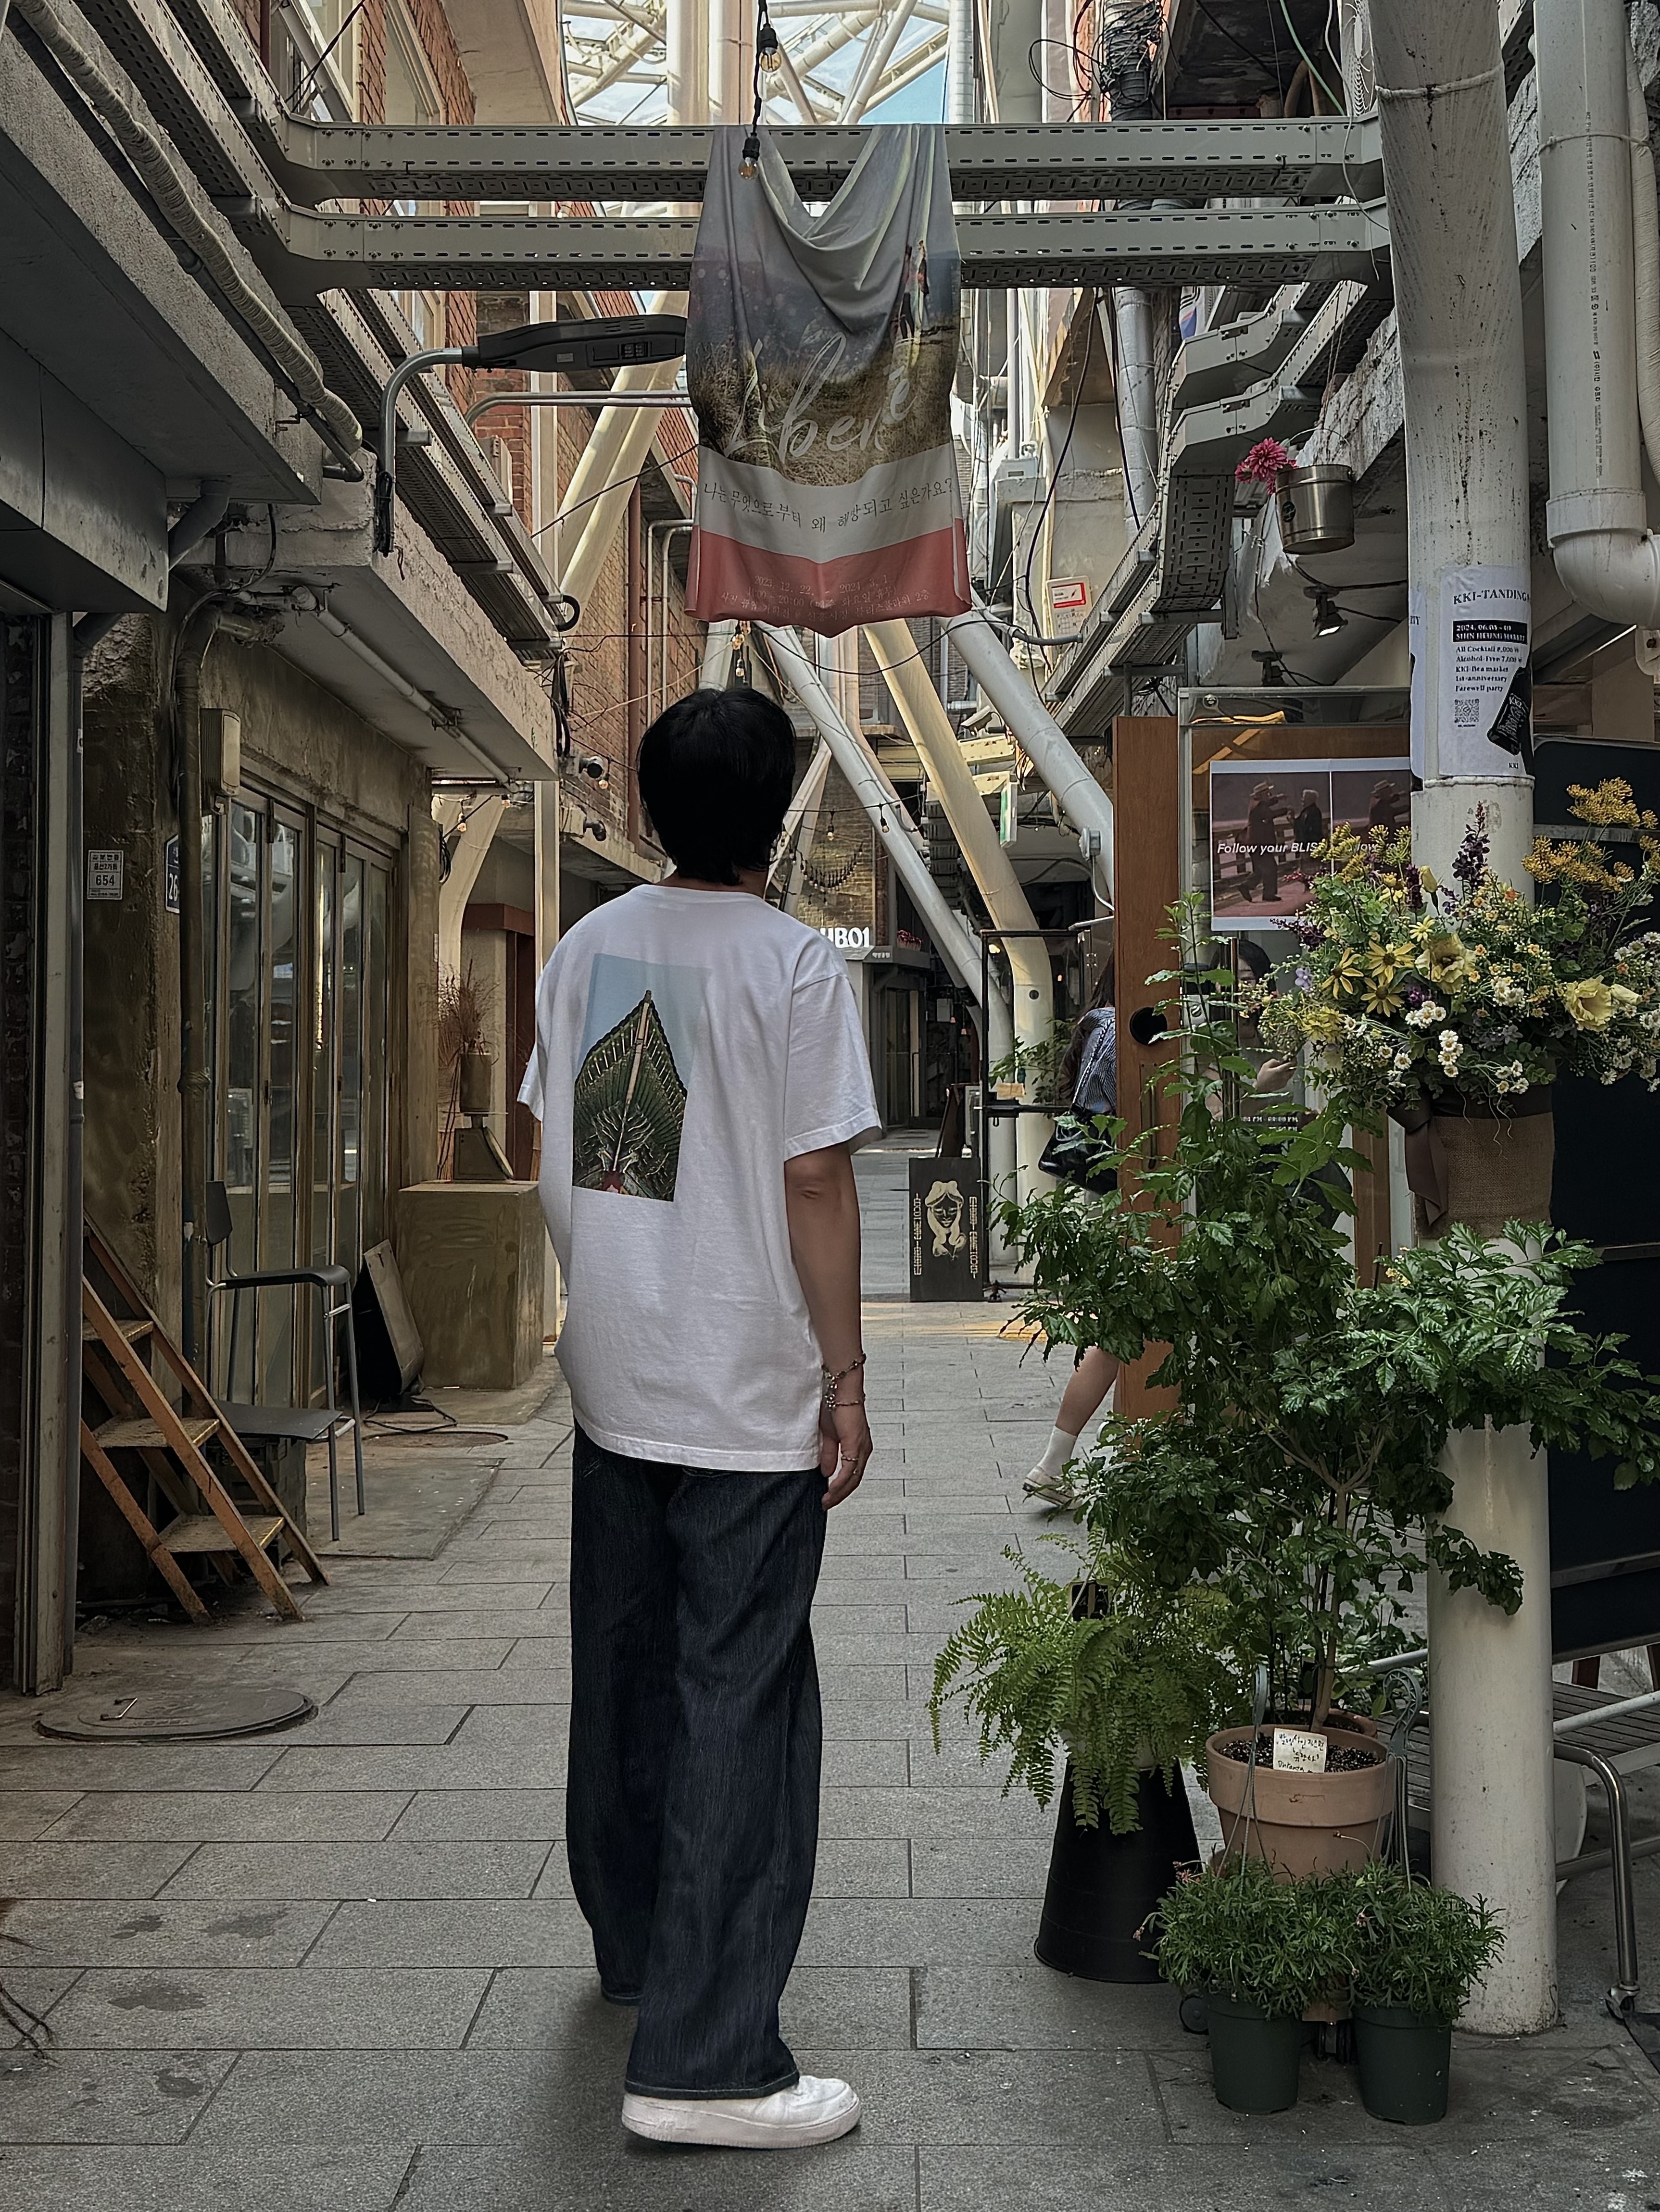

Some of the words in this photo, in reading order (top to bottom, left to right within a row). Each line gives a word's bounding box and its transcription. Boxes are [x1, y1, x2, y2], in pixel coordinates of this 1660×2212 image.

[811, 516, 825, 533] 왜
[838, 499, 892, 527] 해방되고
[898, 478, 952, 510] 싶은가요?
[1217, 843, 1257, 853] Follow
[1260, 845, 1288, 856] your
[1291, 842, 1319, 852] BLIS
[96, 875, 115, 886] 654
